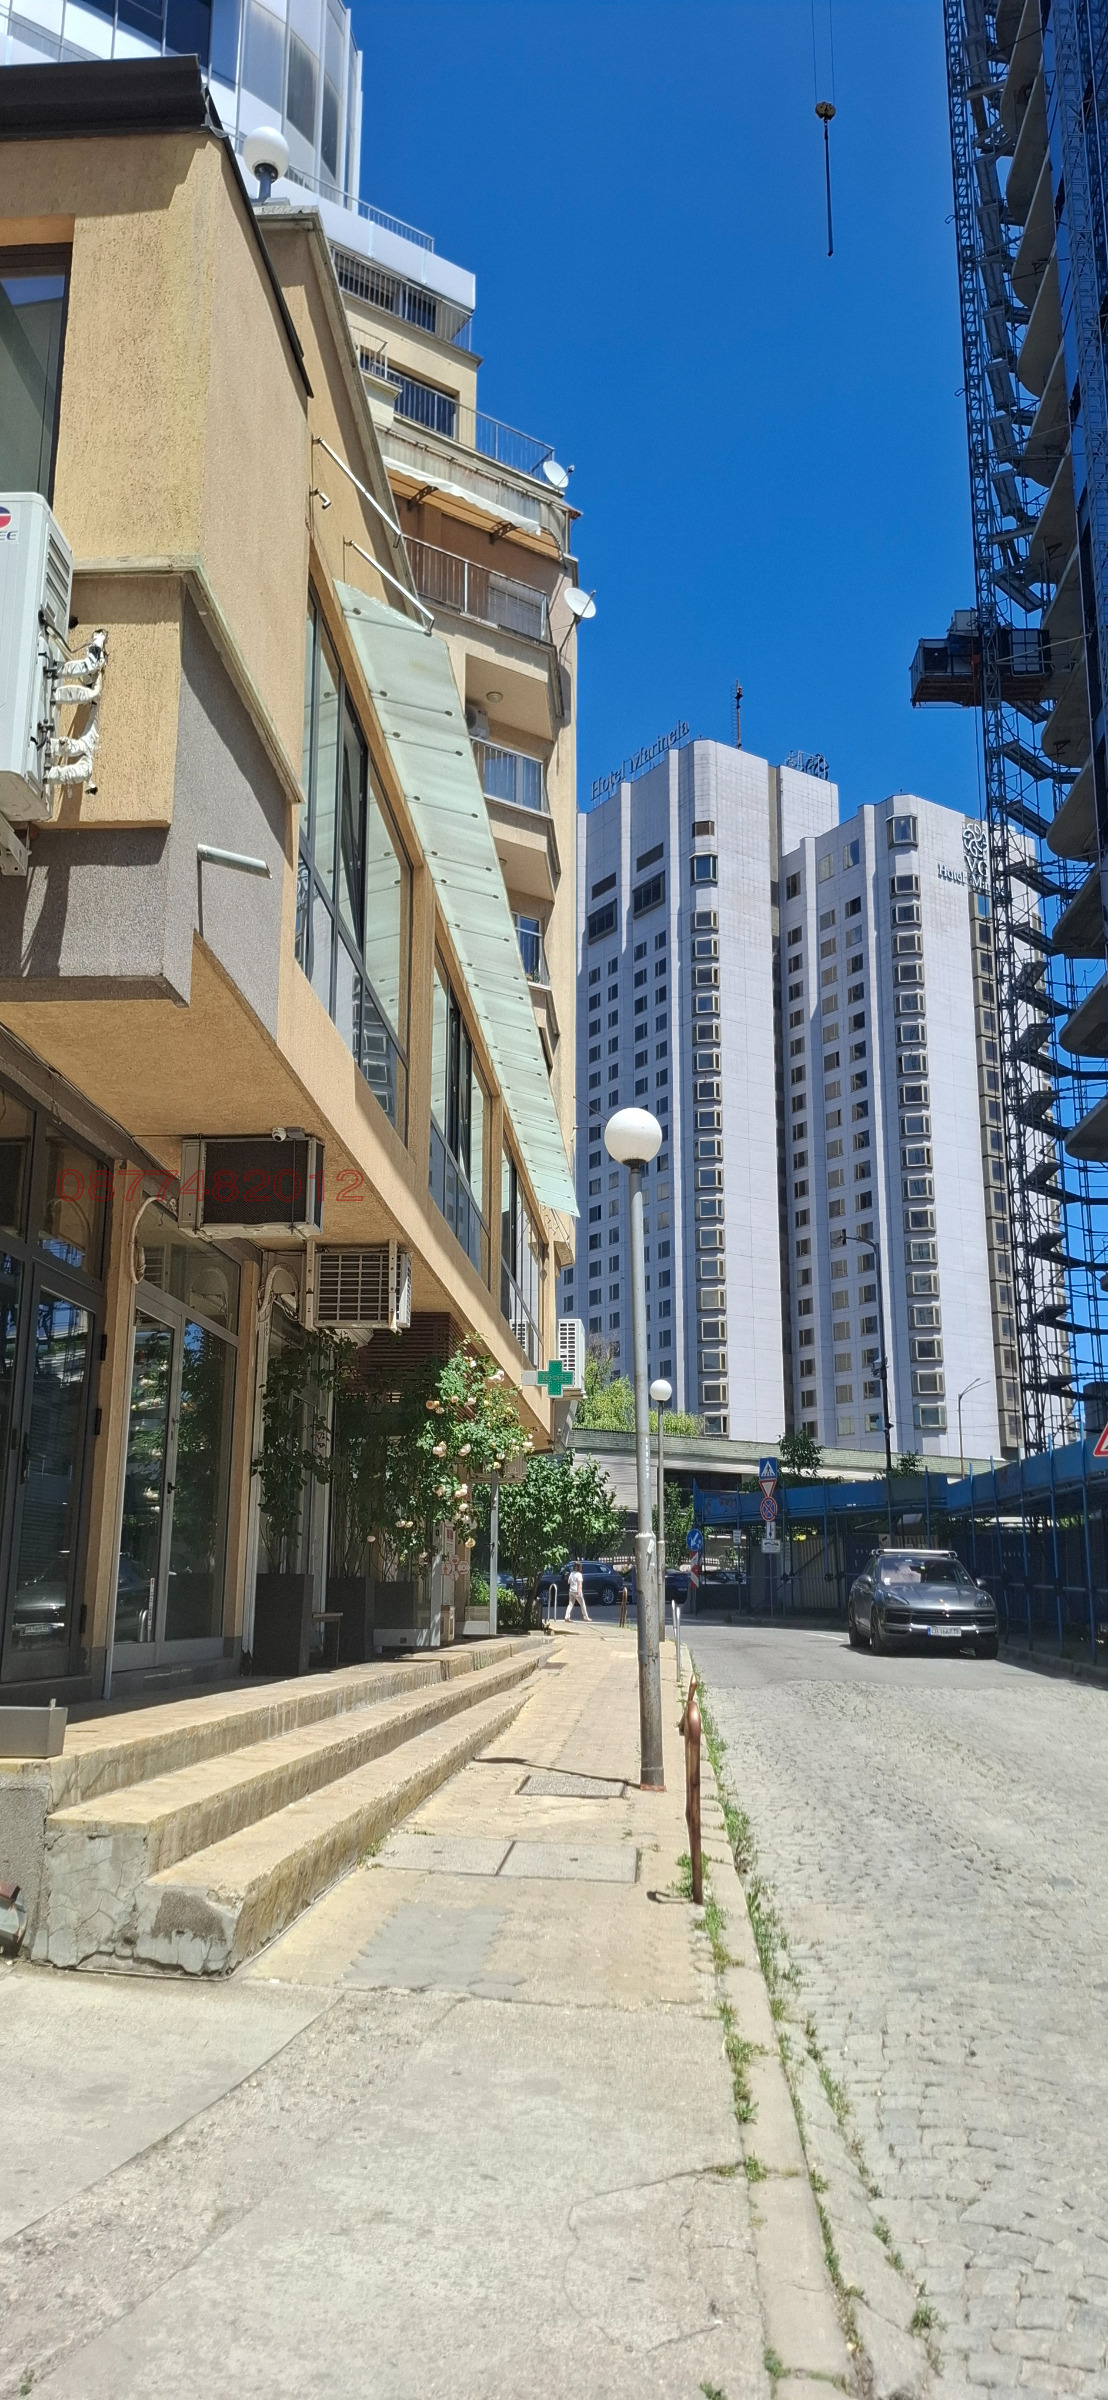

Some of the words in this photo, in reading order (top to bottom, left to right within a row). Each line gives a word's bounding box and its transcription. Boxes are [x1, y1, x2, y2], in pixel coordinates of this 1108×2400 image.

[590, 760, 626, 801] Hotel
[626, 720, 690, 774] Marinela
[938, 863, 965, 883] Hotel
